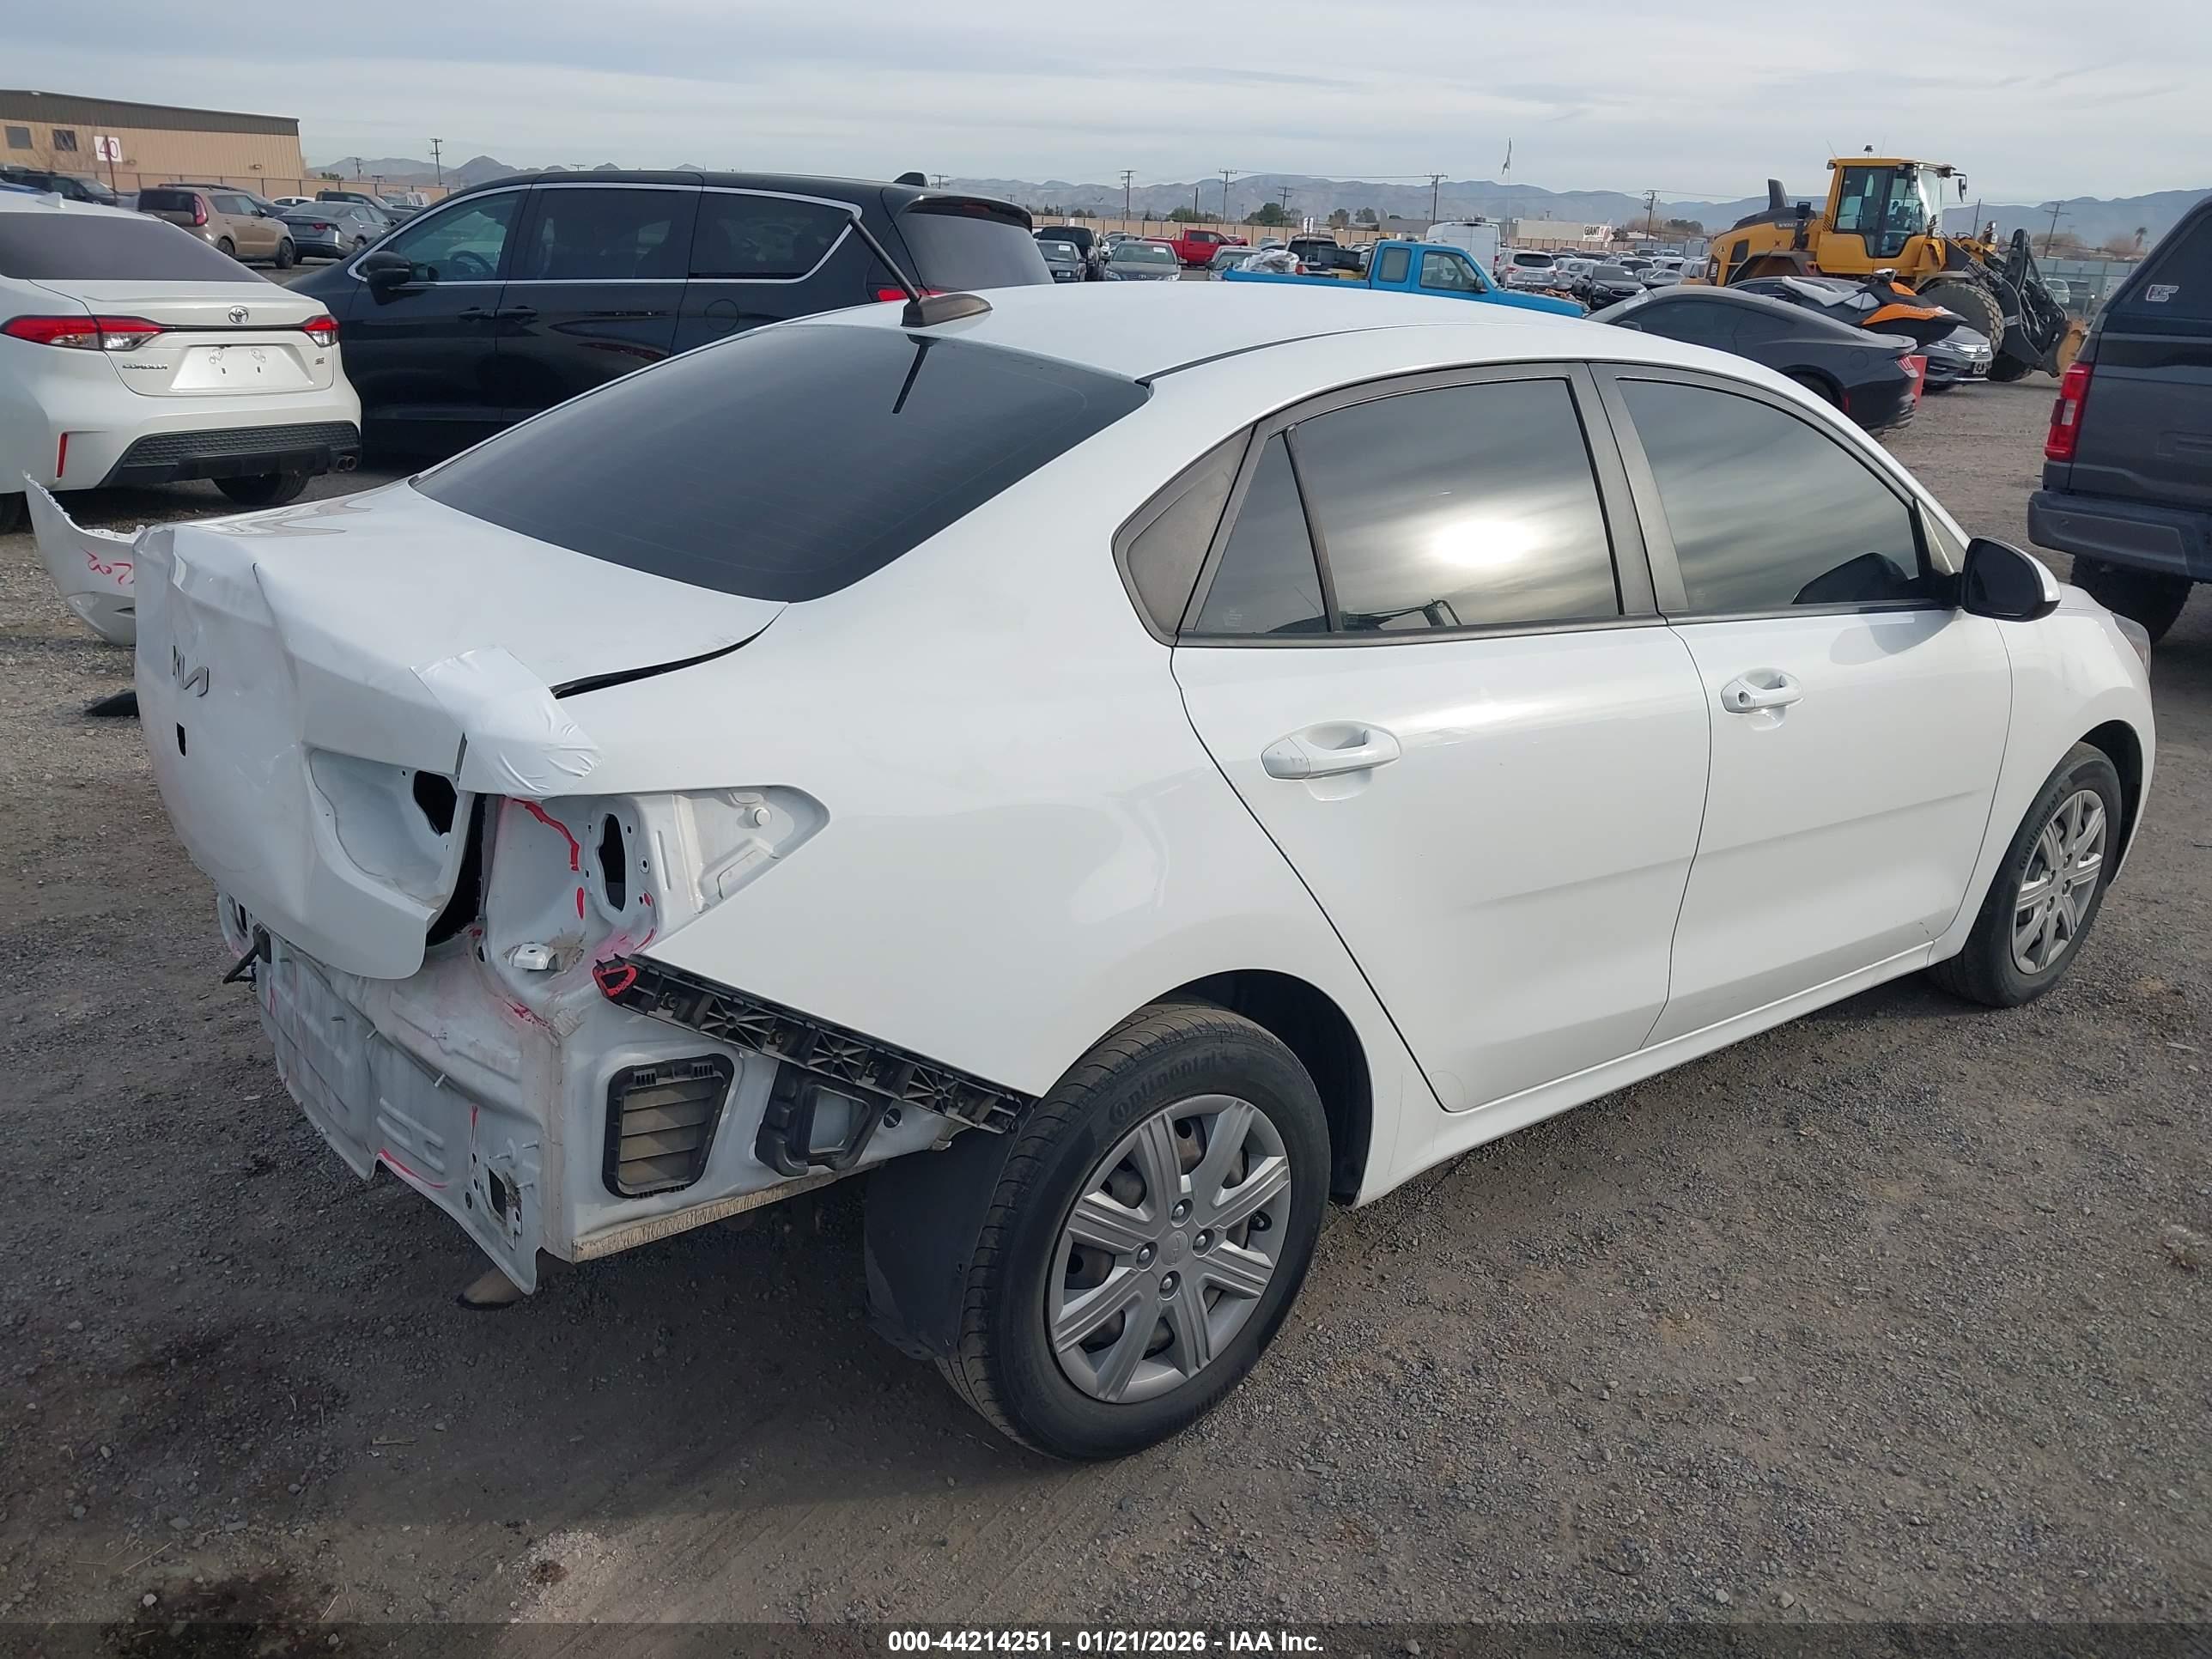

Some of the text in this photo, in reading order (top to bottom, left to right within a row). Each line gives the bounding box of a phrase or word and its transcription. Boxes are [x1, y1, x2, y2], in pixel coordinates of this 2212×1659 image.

[99, 140, 118, 159] 40
[1584, 226, 1601, 236] GIANT
[1109, 1049, 1218, 1127] Continental
